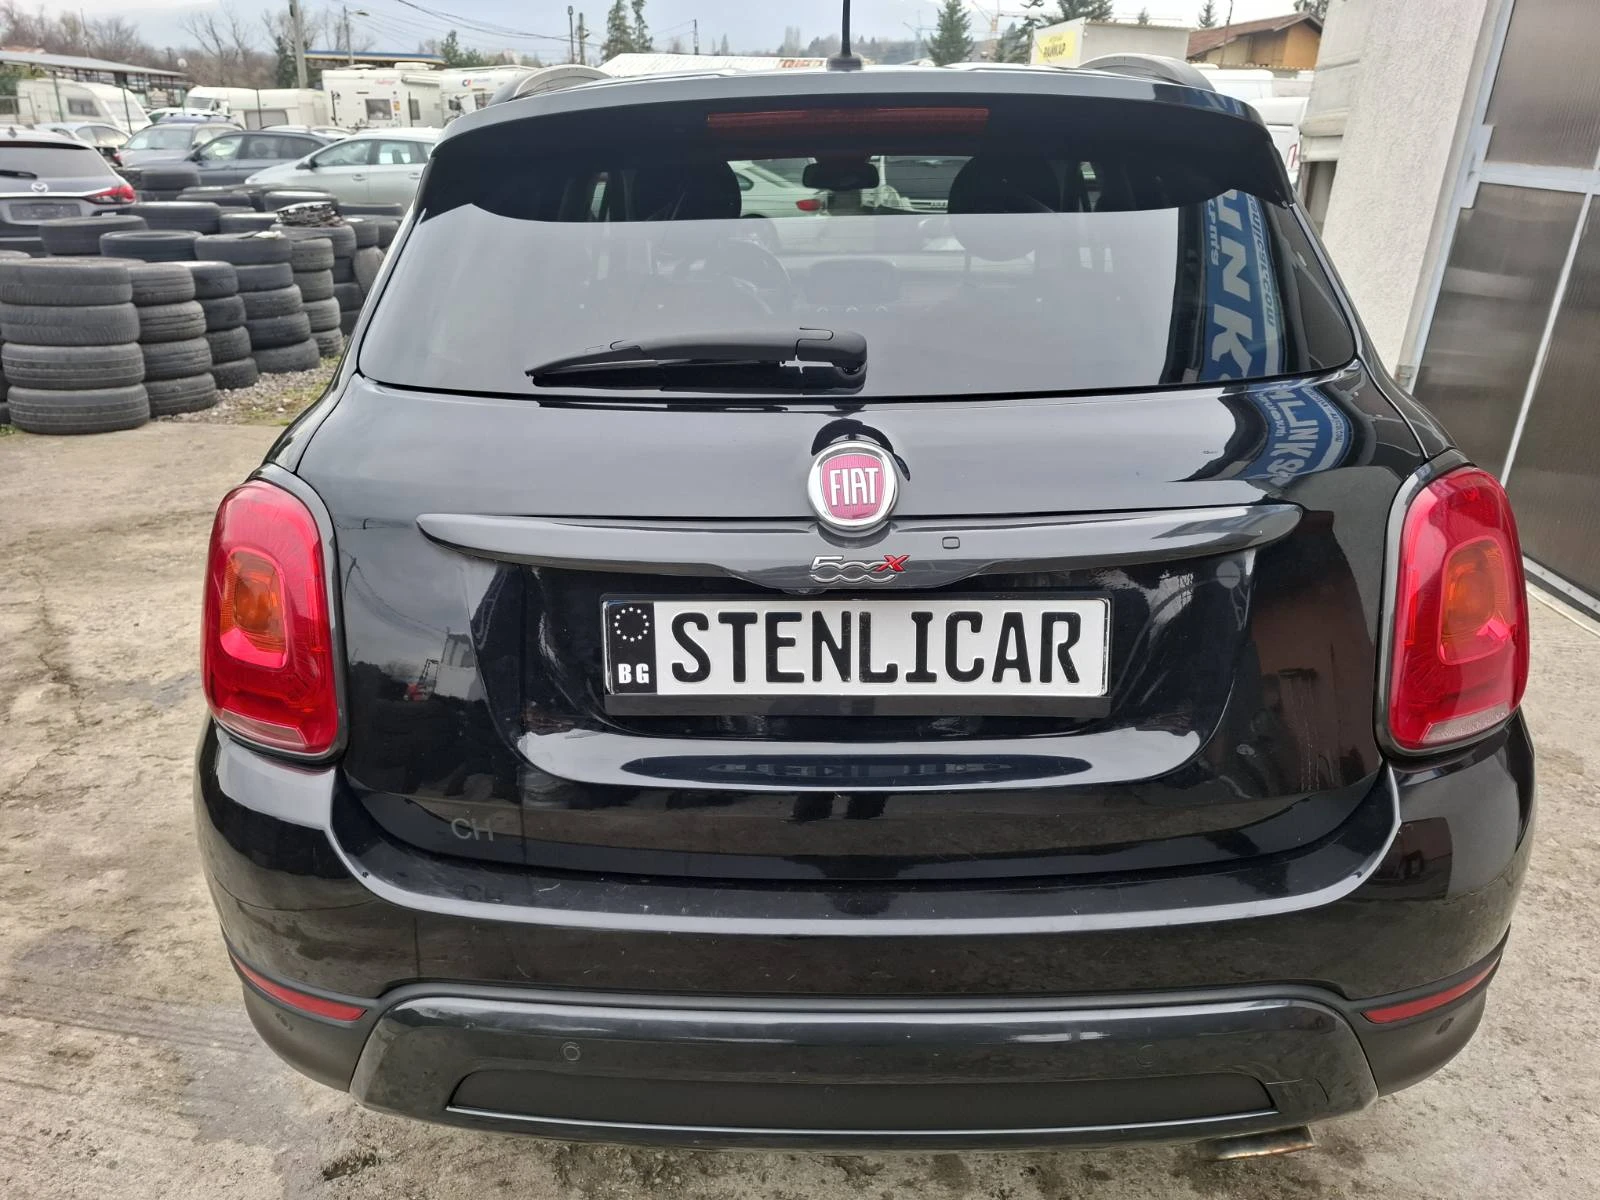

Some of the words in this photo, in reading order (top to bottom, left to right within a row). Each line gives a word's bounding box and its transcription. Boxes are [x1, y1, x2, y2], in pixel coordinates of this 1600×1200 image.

[829, 467, 879, 506] FIAT
[809, 554, 910, 584] 500X
[671, 610, 1082, 684] STENLICAR
[617, 662, 650, 685] BG
[451, 817, 494, 841] CH
